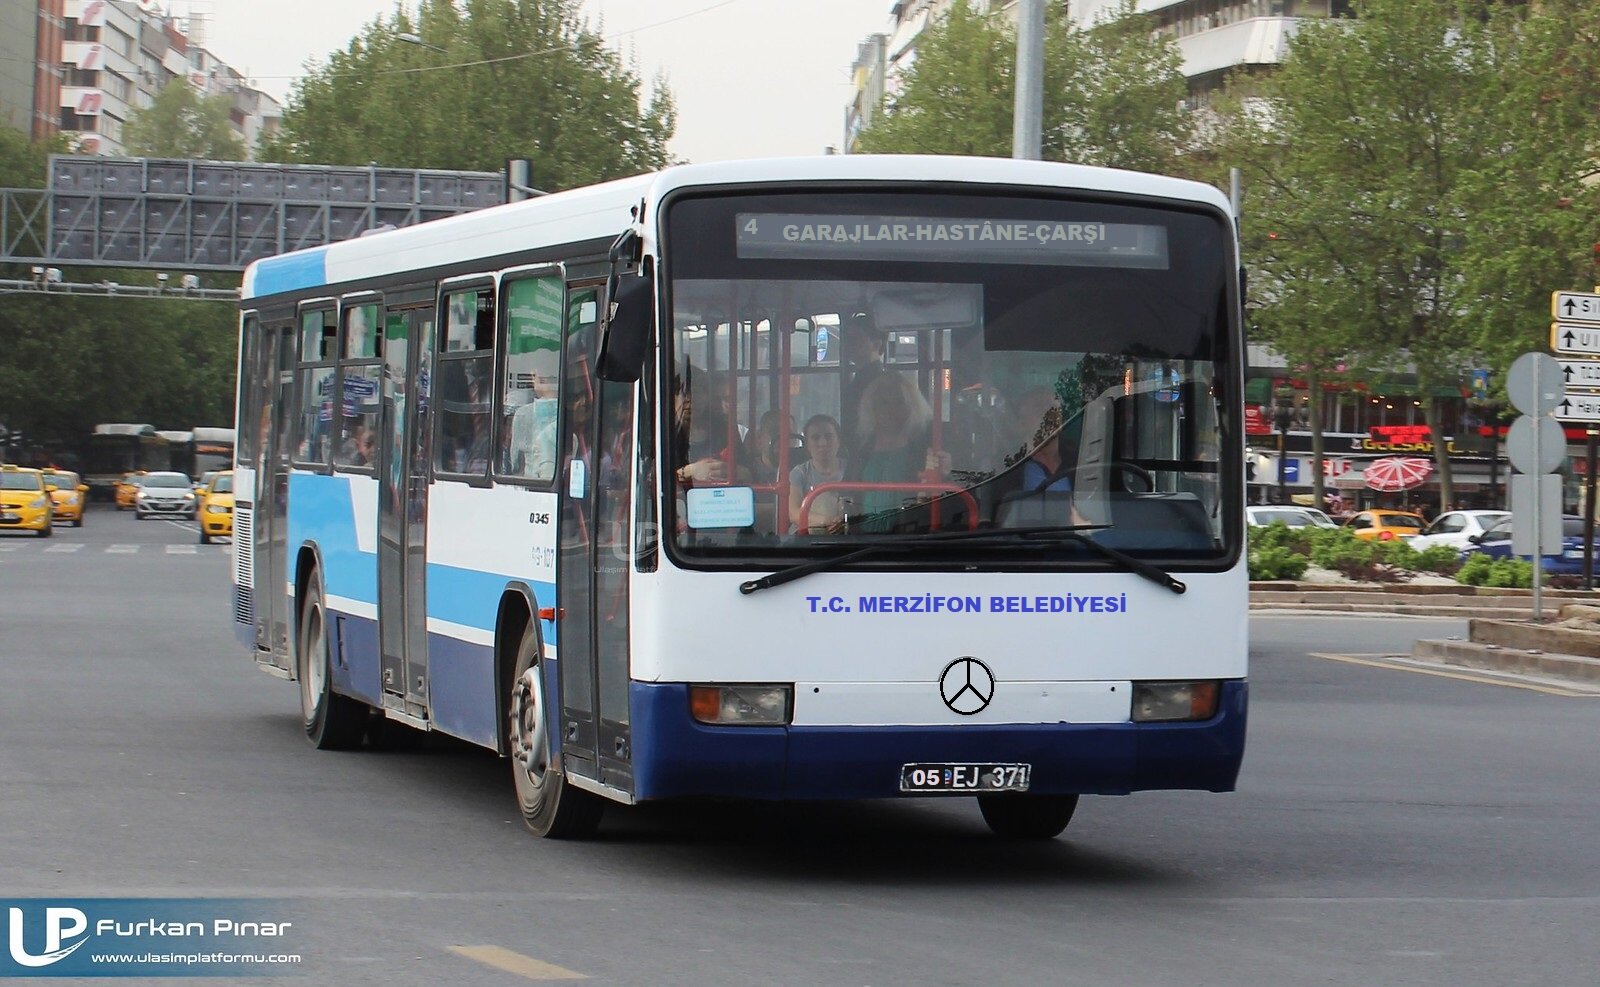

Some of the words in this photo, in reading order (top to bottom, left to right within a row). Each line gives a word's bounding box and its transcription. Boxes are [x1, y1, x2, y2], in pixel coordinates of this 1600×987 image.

[744, 219, 758, 234] 4
[783, 220, 1106, 245] GARAJLAR-HASTÂNE-ÇARŞI
[529, 512, 551, 525] 0345
[806, 597, 850, 613] T.C.
[859, 593, 982, 613] MERZİFON
[990, 593, 1127, 613] BELEDİYESİ
[912, 769, 940, 786] 05
[952, 766, 979, 788] EJ
[991, 766, 1027, 788] 371
